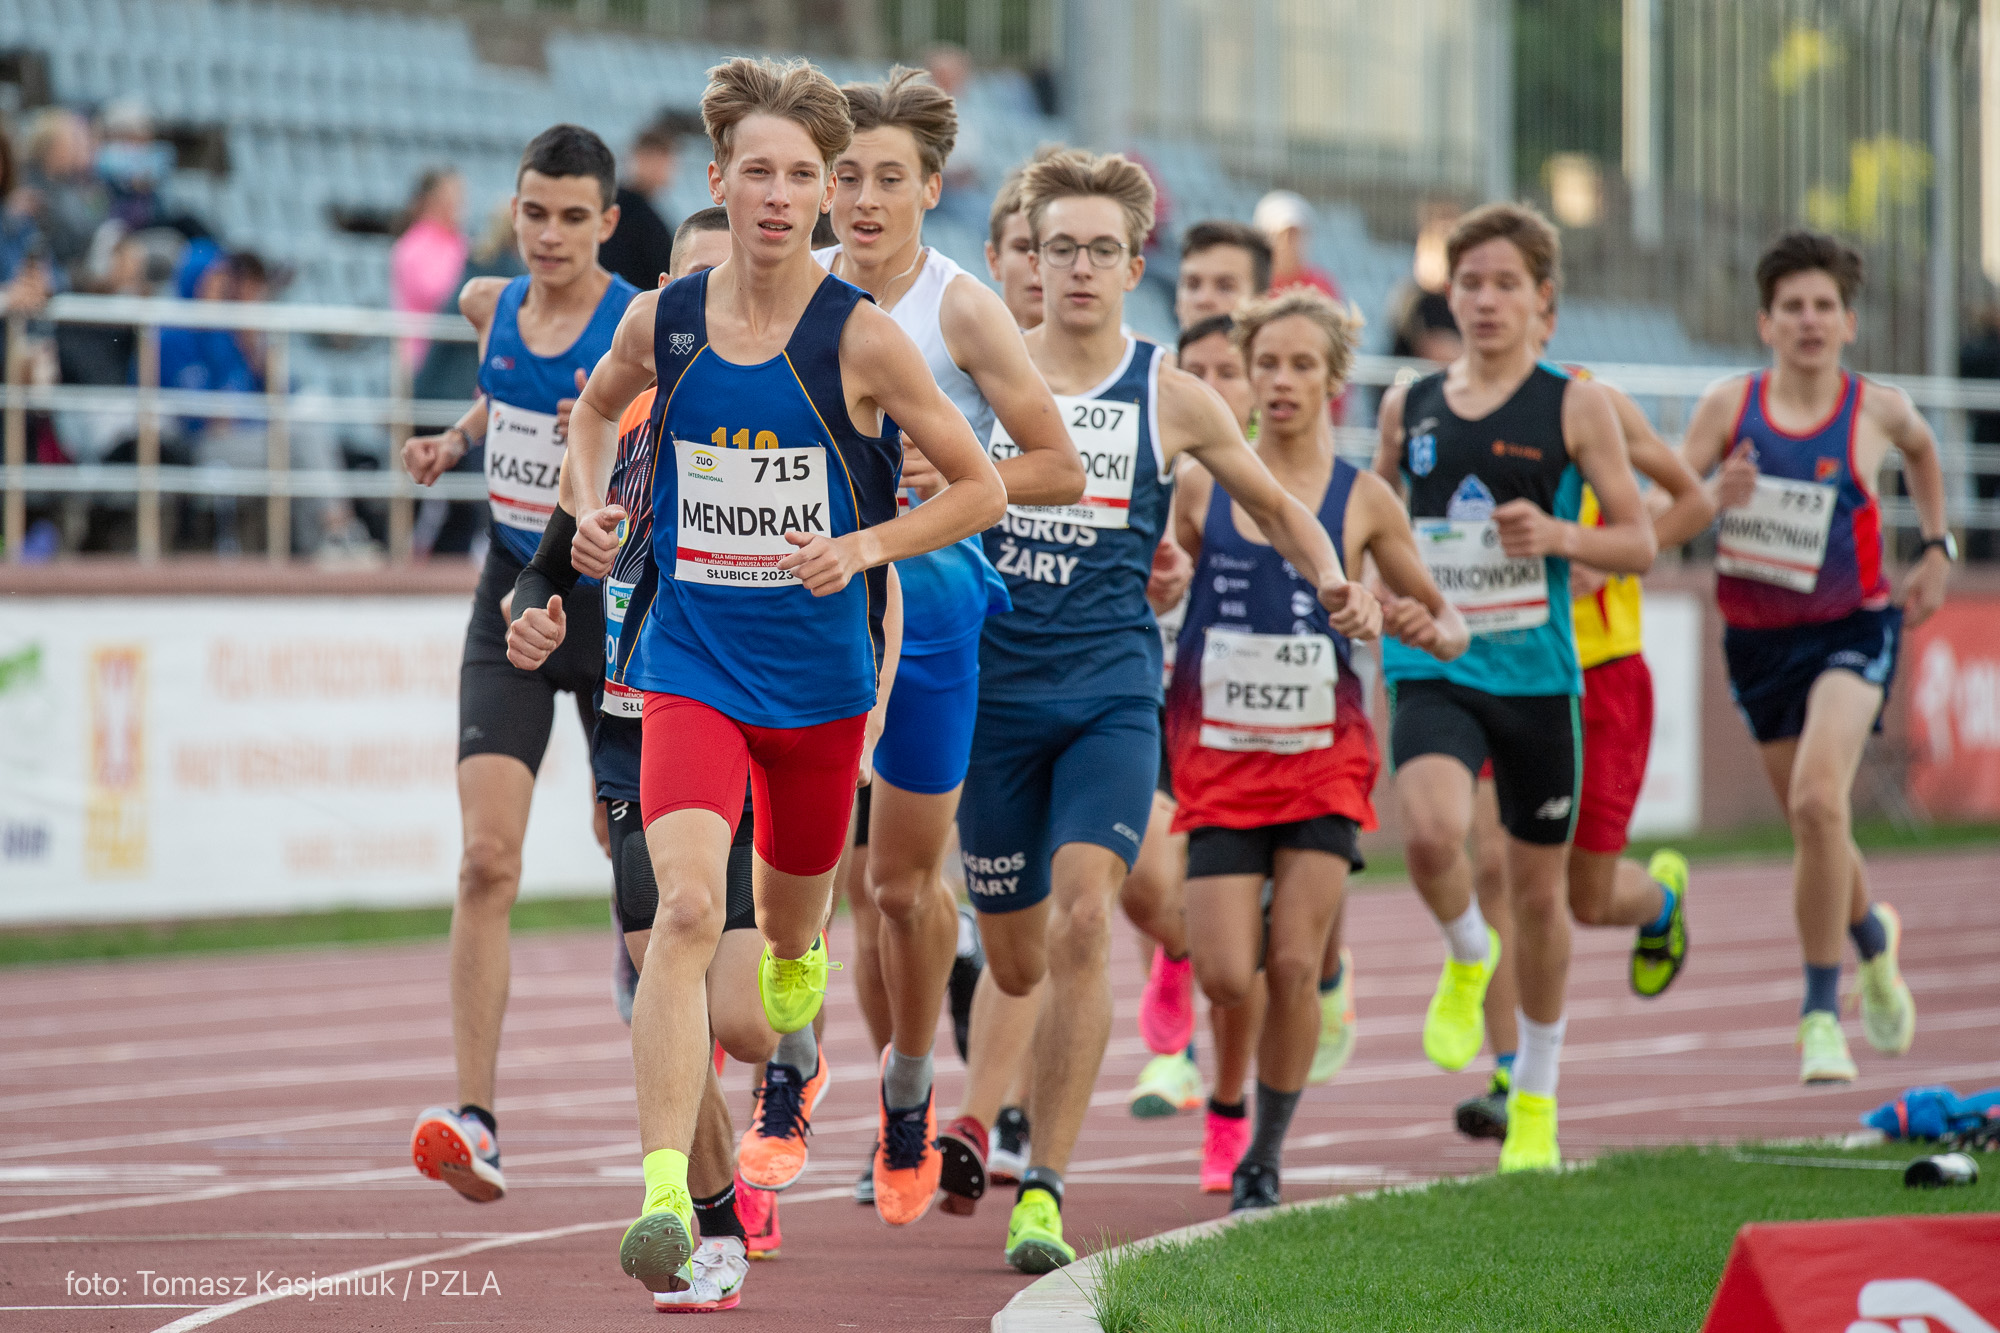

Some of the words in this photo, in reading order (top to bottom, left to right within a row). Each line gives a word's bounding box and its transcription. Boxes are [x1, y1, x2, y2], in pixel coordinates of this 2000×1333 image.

[1073, 405, 1124, 431] 207
[490, 453, 561, 489] KASZA
[696, 456, 713, 467] ZUO
[751, 455, 811, 483] 715
[687, 471, 724, 483] INTERNATIONAL
[682, 498, 824, 536] MENDRAK
[993, 512, 1098, 548] AGROS
[706, 568, 758, 581] SŁUBICE
[761, 570, 793, 581] 2023
[996, 538, 1080, 586] ŻARY
[1274, 642, 1322, 666] 437
[622, 702, 644, 712] SŁU
[1226, 681, 1311, 711] PESZT
